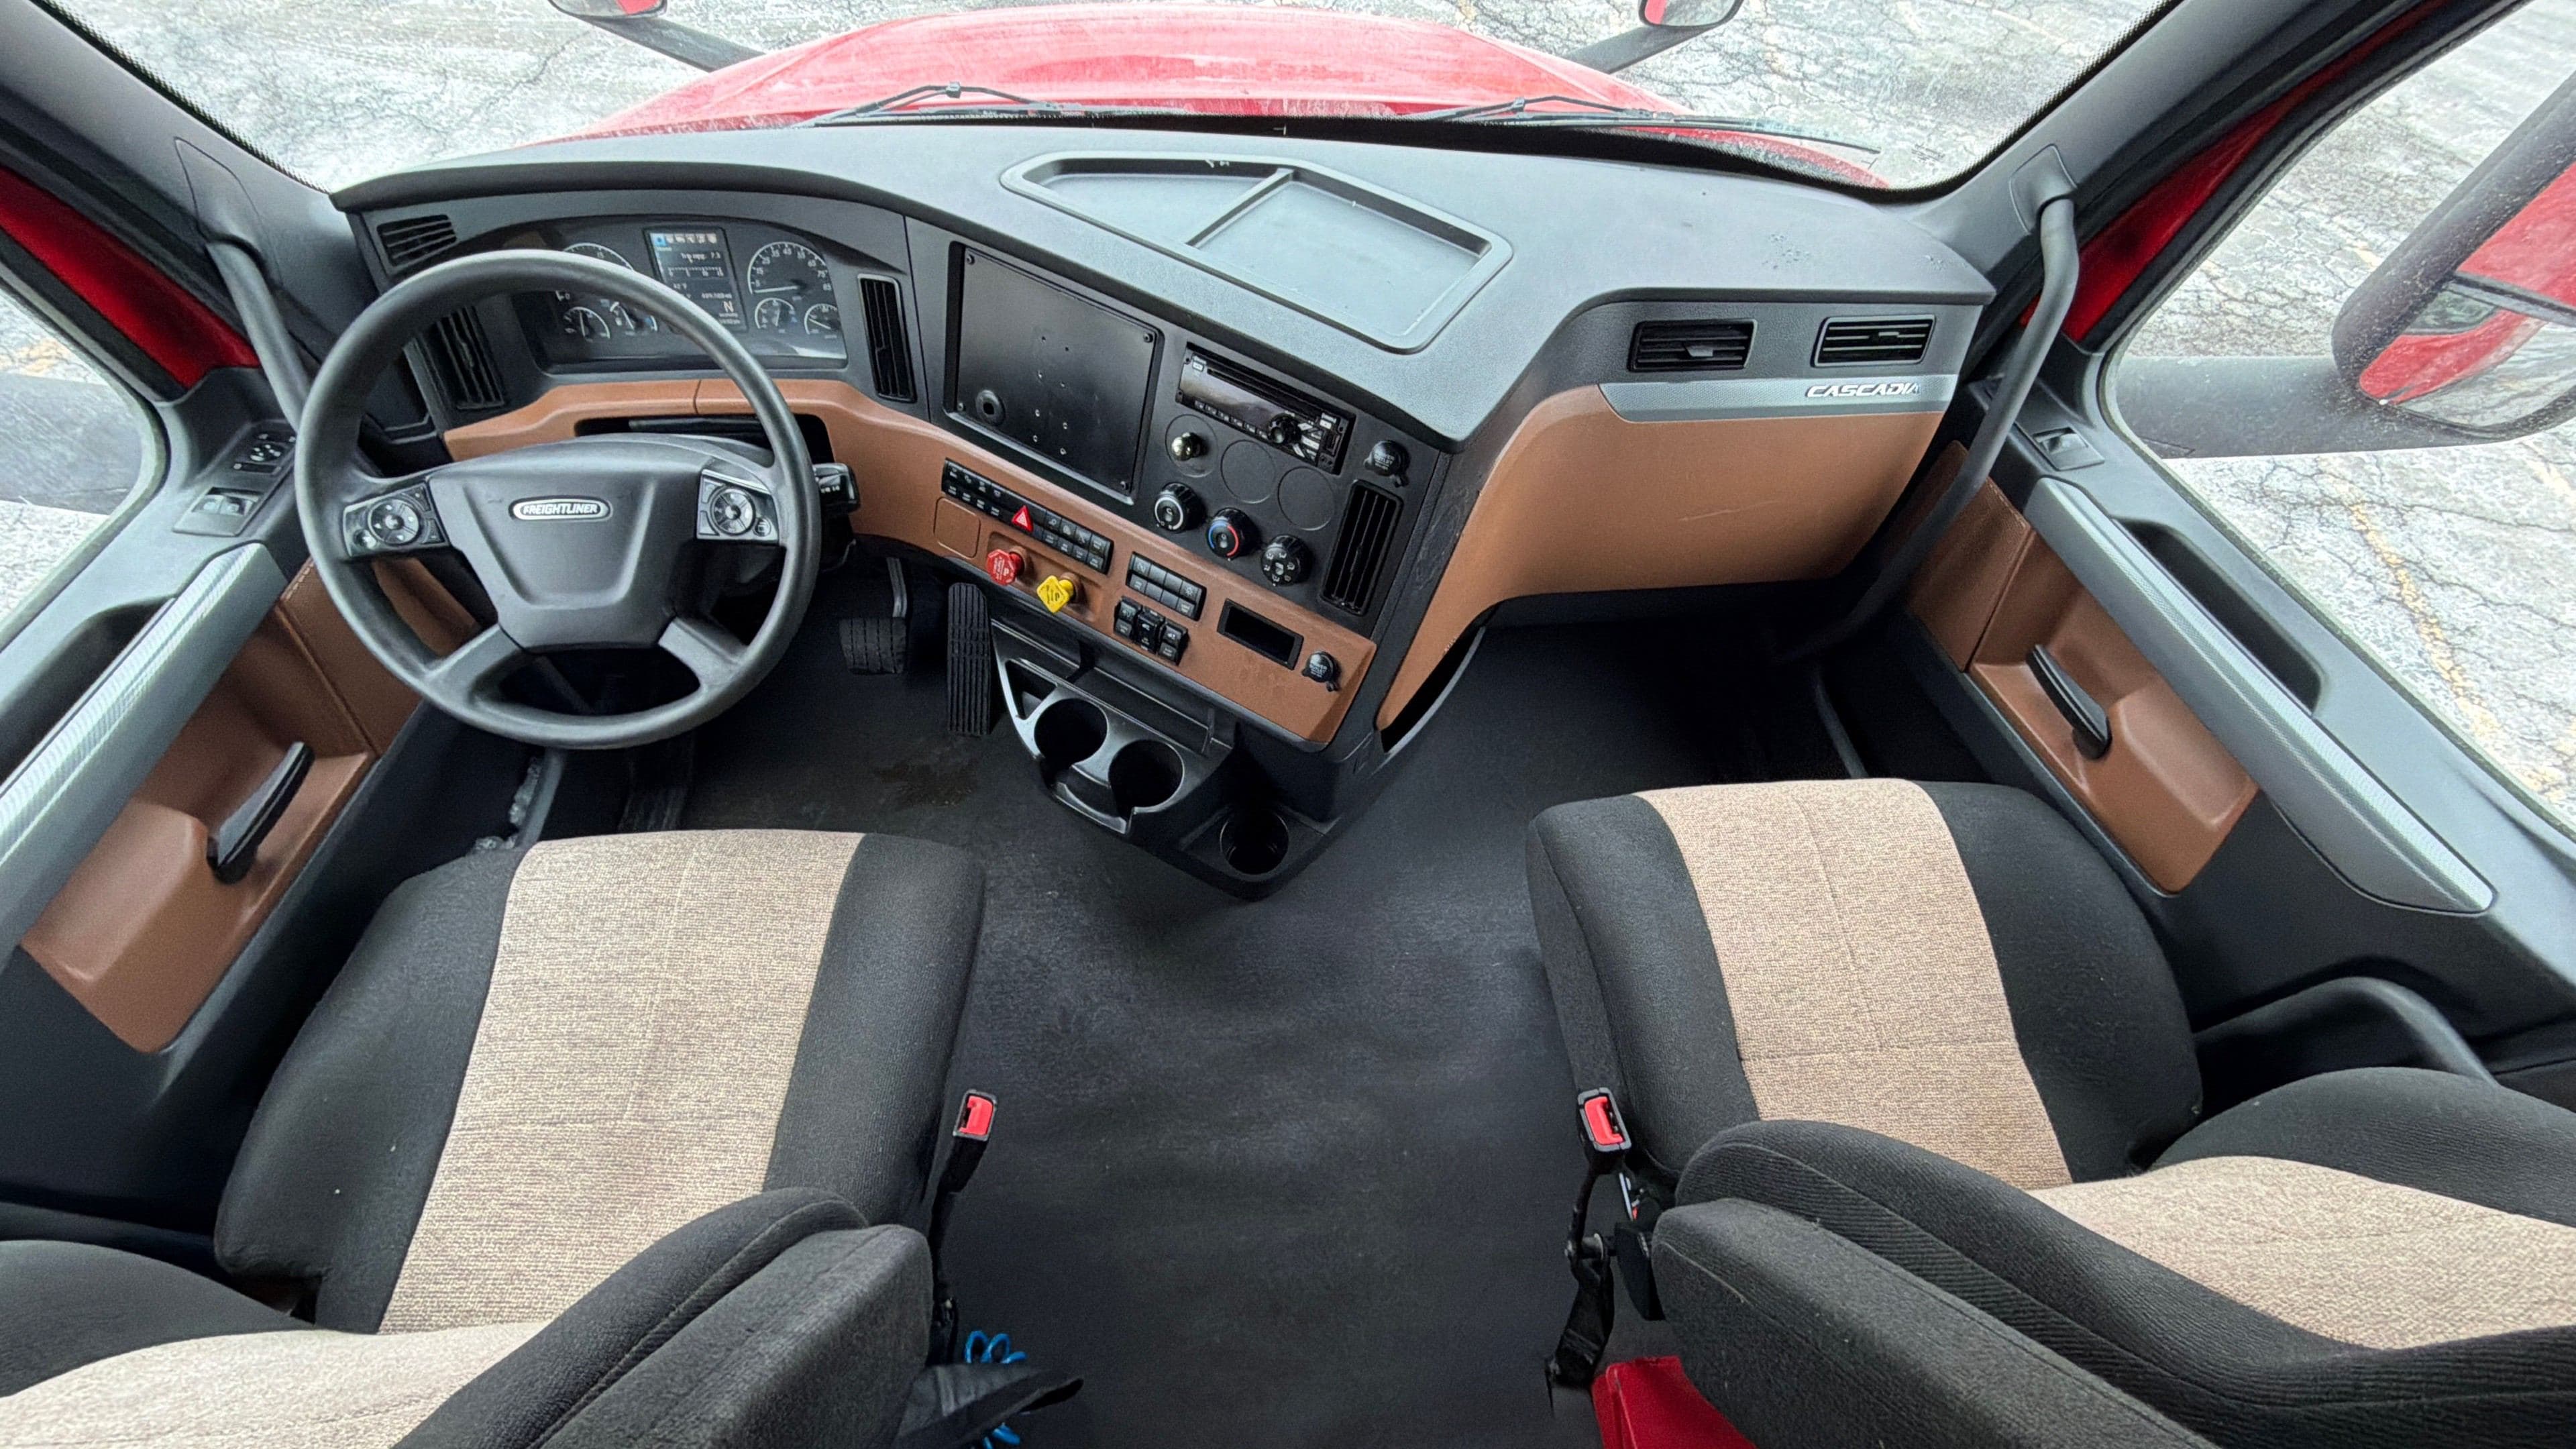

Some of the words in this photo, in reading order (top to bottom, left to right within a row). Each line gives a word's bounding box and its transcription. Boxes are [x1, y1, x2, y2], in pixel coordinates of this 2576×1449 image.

[723, 301, 734, 313] N
[1807, 382, 1921, 398] CASCADIA
[523, 502, 598, 515] FREIGHTLINER
